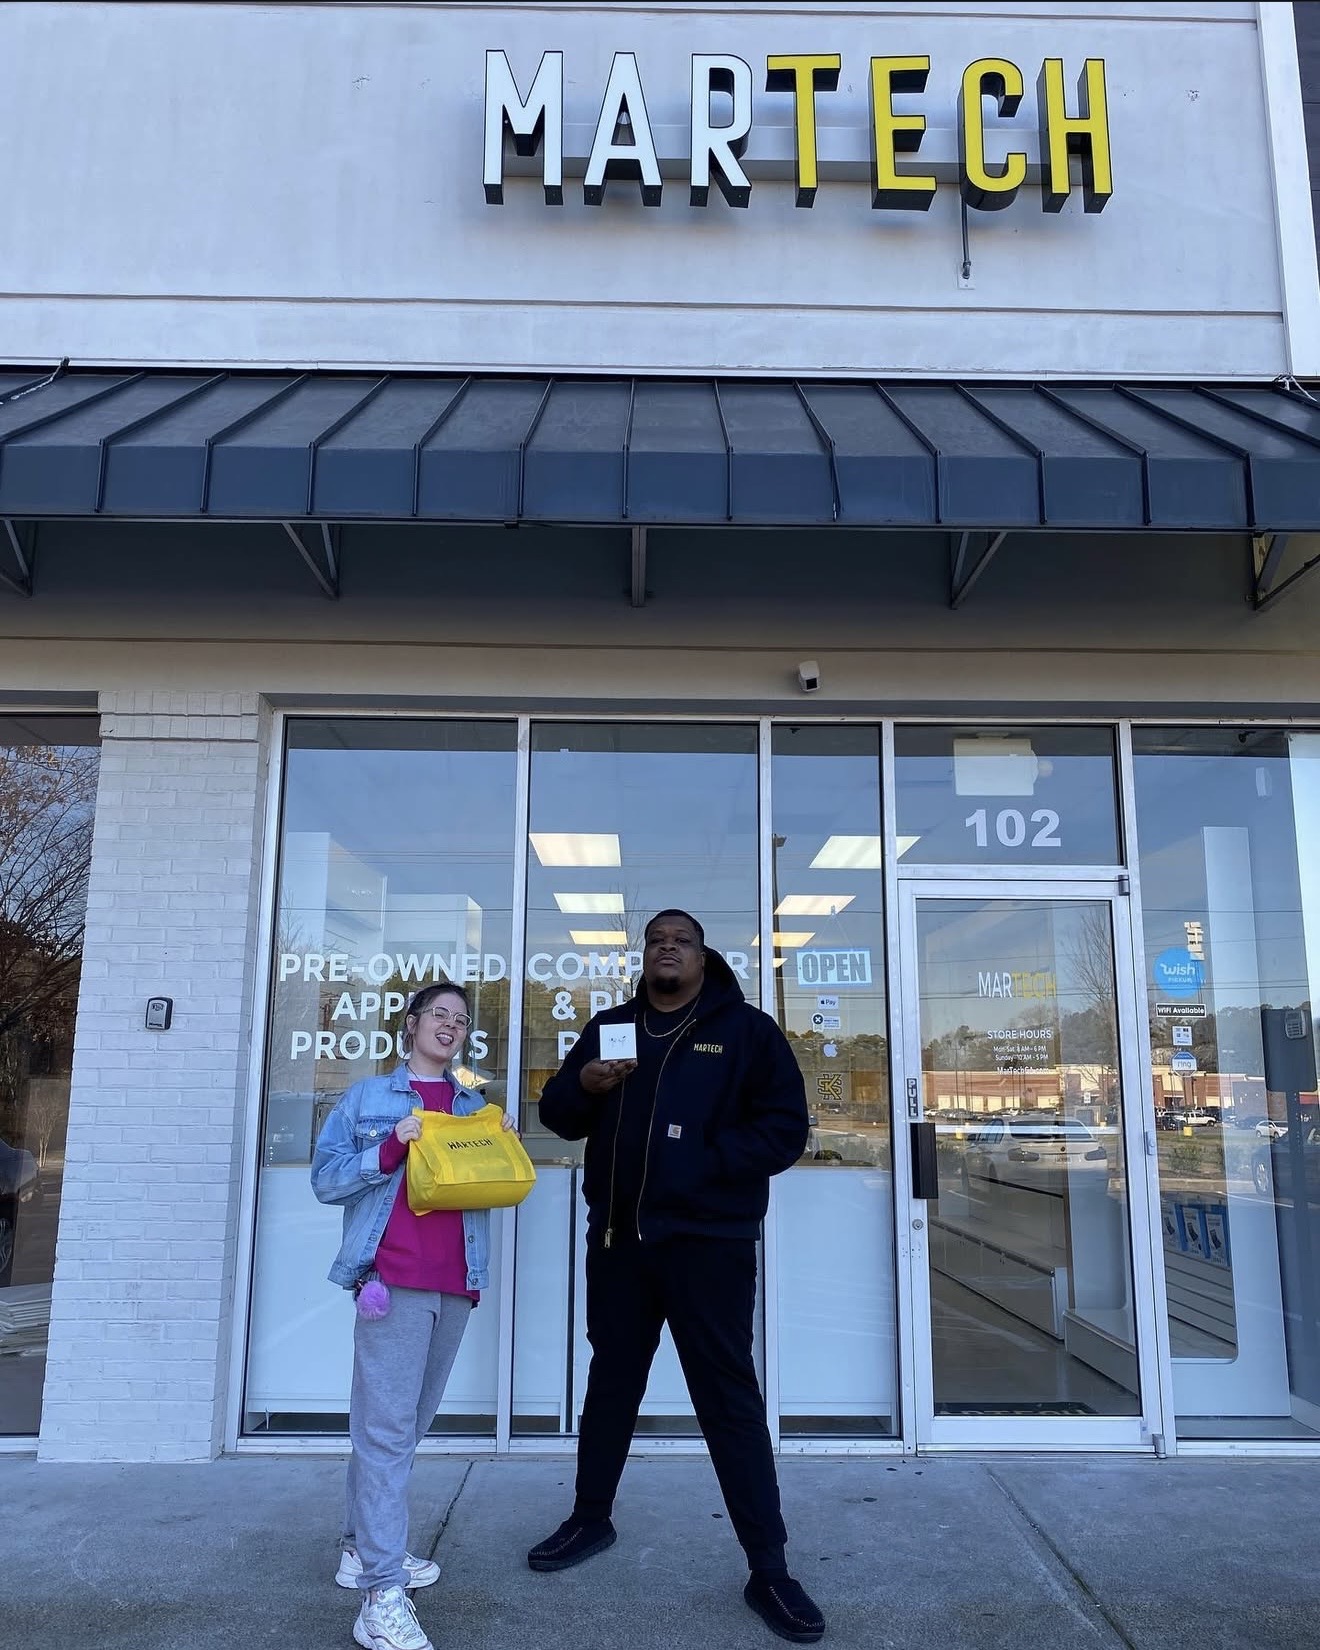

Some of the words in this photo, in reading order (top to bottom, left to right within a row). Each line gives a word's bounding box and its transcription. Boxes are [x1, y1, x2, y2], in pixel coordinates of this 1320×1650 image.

[483, 50, 1114, 204] MARTECH
[965, 809, 1062, 847] 102
[279, 953, 507, 983] PRE-OWNED
[527, 951, 751, 982] COMPR
[802, 953, 867, 983] OPEN
[1160, 963, 1196, 976] wish
[978, 971, 1057, 999] MARTECH
[551, 991, 577, 1021] &
[693, 1043, 723, 1054] MARTECH
[987, 1030, 1017, 1039] STORE
[1019, 1029, 1052, 1039] HOURS
[908, 1079, 918, 1117] PULL
[447, 1138, 493, 1150] MARTECH
